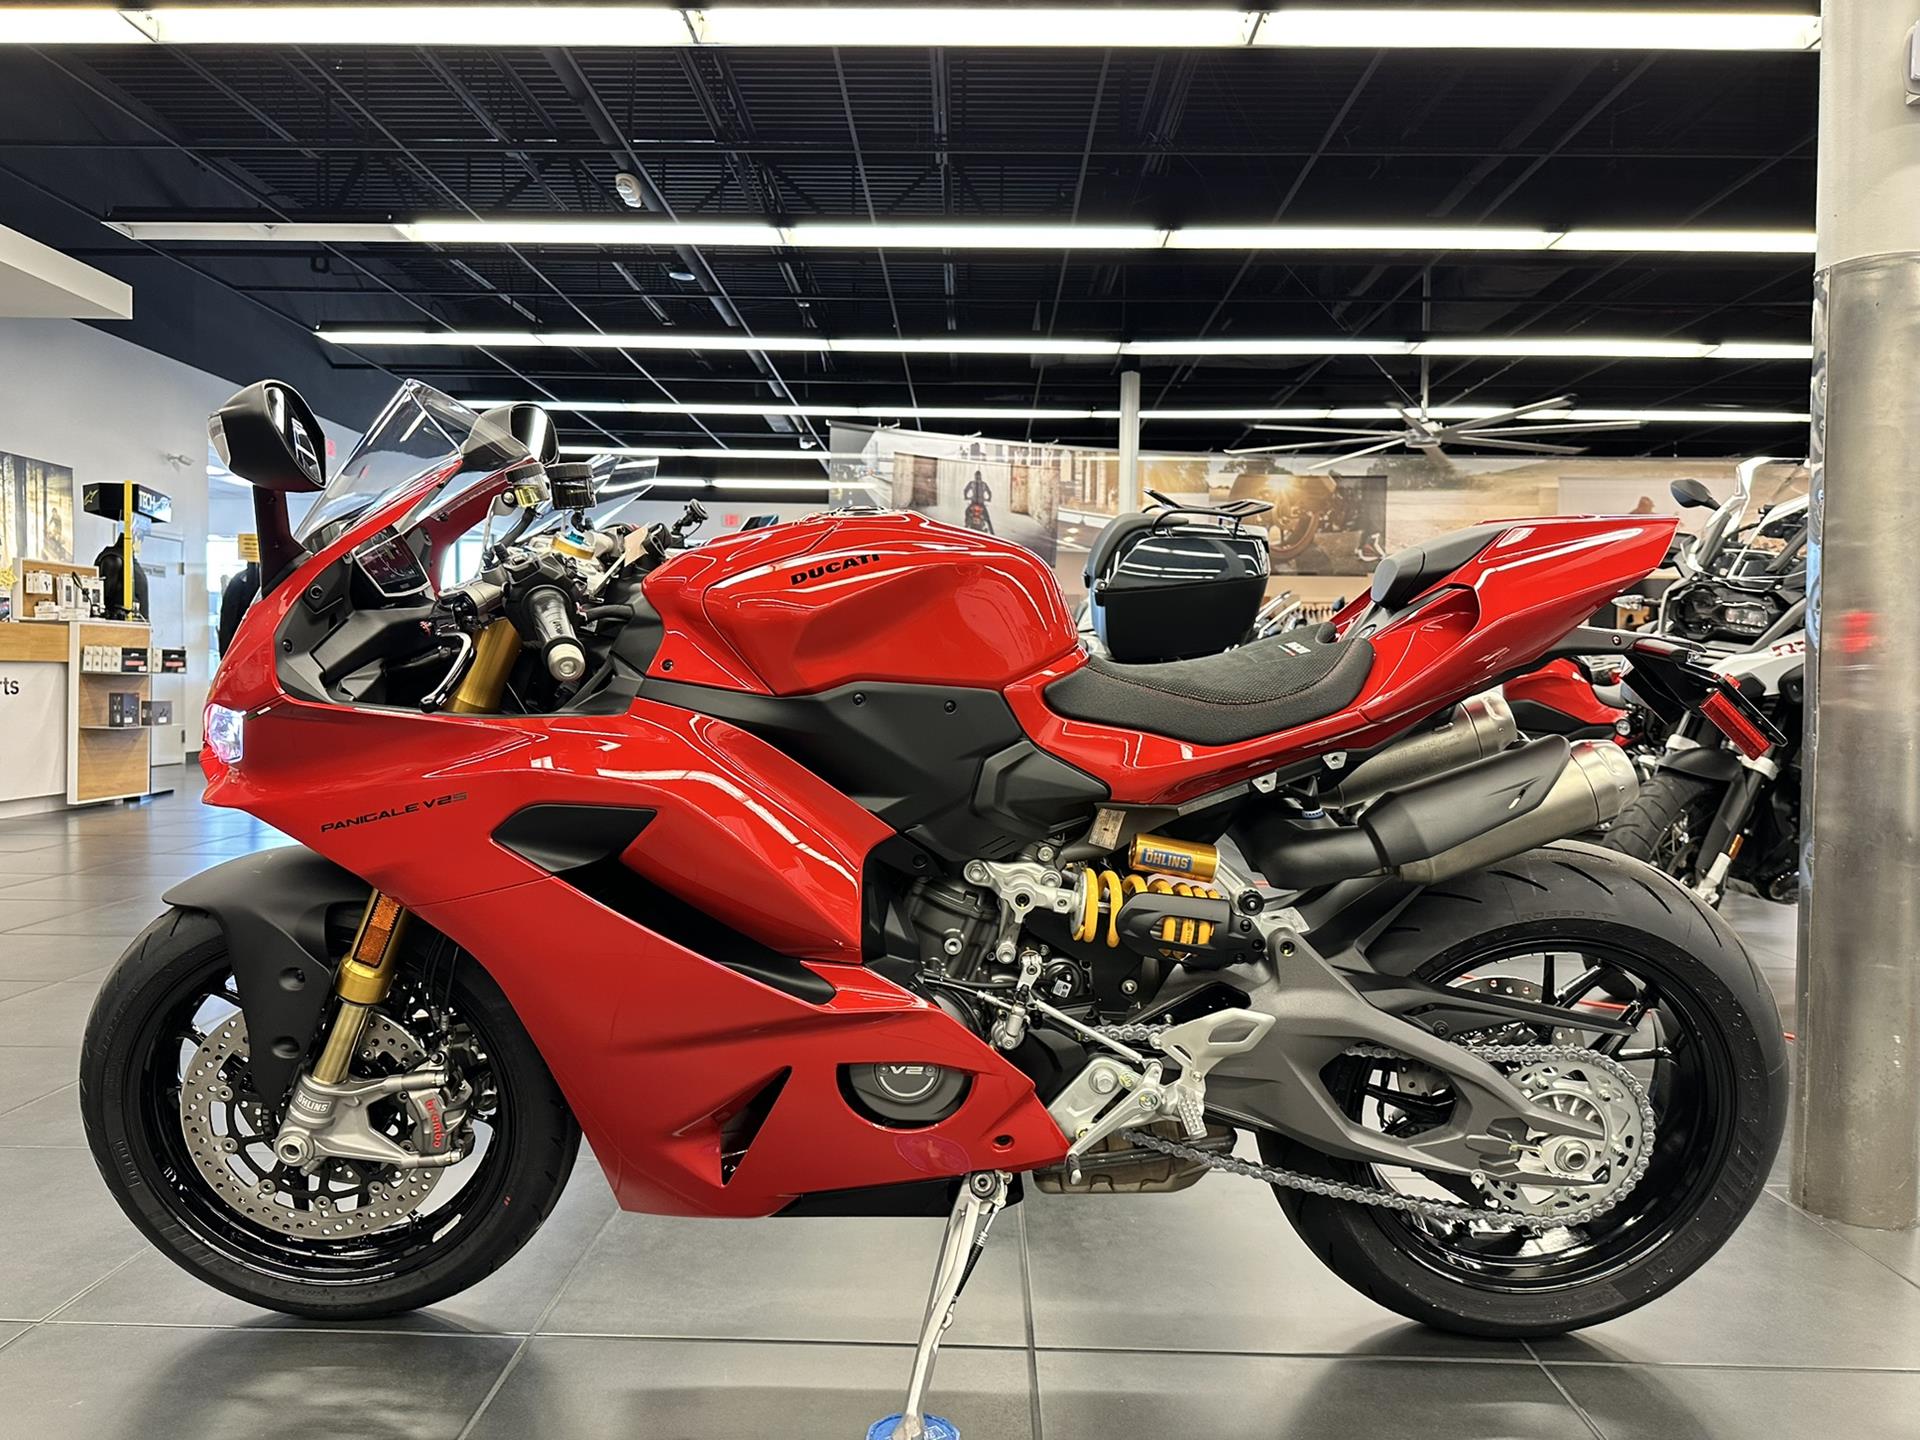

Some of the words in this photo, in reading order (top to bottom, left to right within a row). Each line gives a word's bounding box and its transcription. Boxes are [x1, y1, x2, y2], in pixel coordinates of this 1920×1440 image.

[790, 553, 880, 585] DUCATI
[320, 802, 420, 833] PANIGALE
[423, 791, 469, 809] V2S
[889, 1065, 925, 1075] V2
[425, 1098, 445, 1148] brembo
